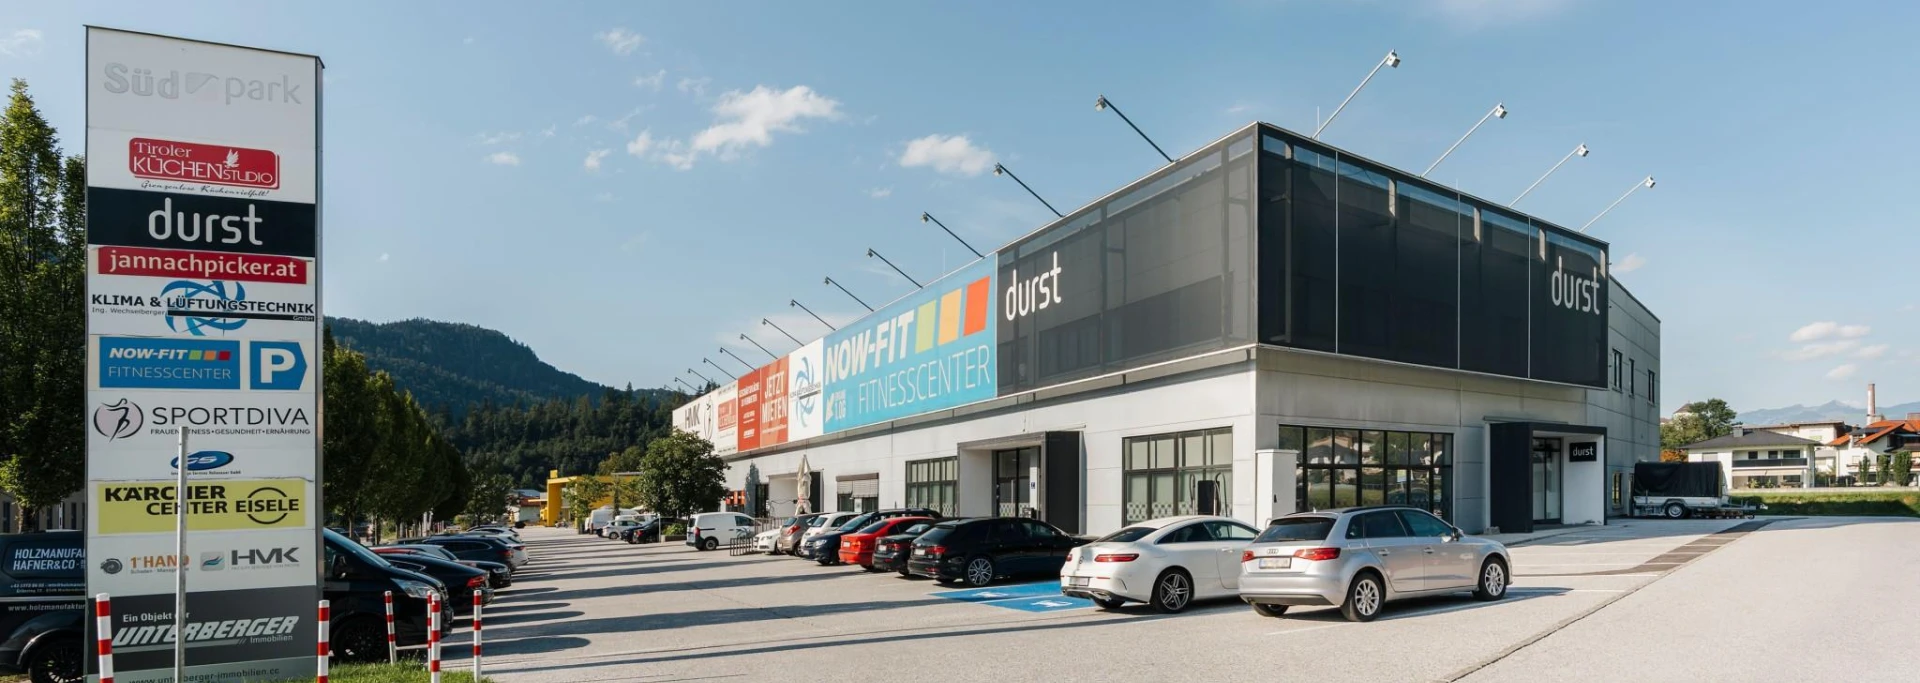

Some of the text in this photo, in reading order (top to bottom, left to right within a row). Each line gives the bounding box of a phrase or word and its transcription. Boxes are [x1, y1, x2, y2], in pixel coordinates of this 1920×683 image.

[104, 62, 302, 105] Süd park
[134, 141, 192, 158] Tiroler
[149, 197, 263, 246] durst
[109, 250, 297, 277] jannachpicker.at
[1006, 251, 1062, 321] durst
[1551, 255, 1600, 315] durst
[92, 294, 315, 314] KLIMA & LÜFTUNGSTECHNIK
[109, 347, 188, 360] NOW-FIT
[825, 309, 914, 386] NOW-FIT
[108, 366, 231, 379] FITNESSCENTER
[260, 348, 296, 384] P
[765, 370, 785, 399] JETZT
[859, 344, 991, 414] FITNESSCENTER
[152, 406, 309, 425] SPORTDIVA
[762, 395, 788, 423] MIETEN
[1572, 446, 1594, 457] durst
[235, 498, 299, 513] EISELE
[13, 559, 75, 571] HAFNER&CO
[143, 555, 190, 568] HAND
[231, 547, 299, 565] HMK
[123, 614, 138, 623] Ein
[140, 611, 172, 624] Objekt
[112, 616, 300, 647] UNTERBERGER
[250, 634, 293, 644] Immobilien
